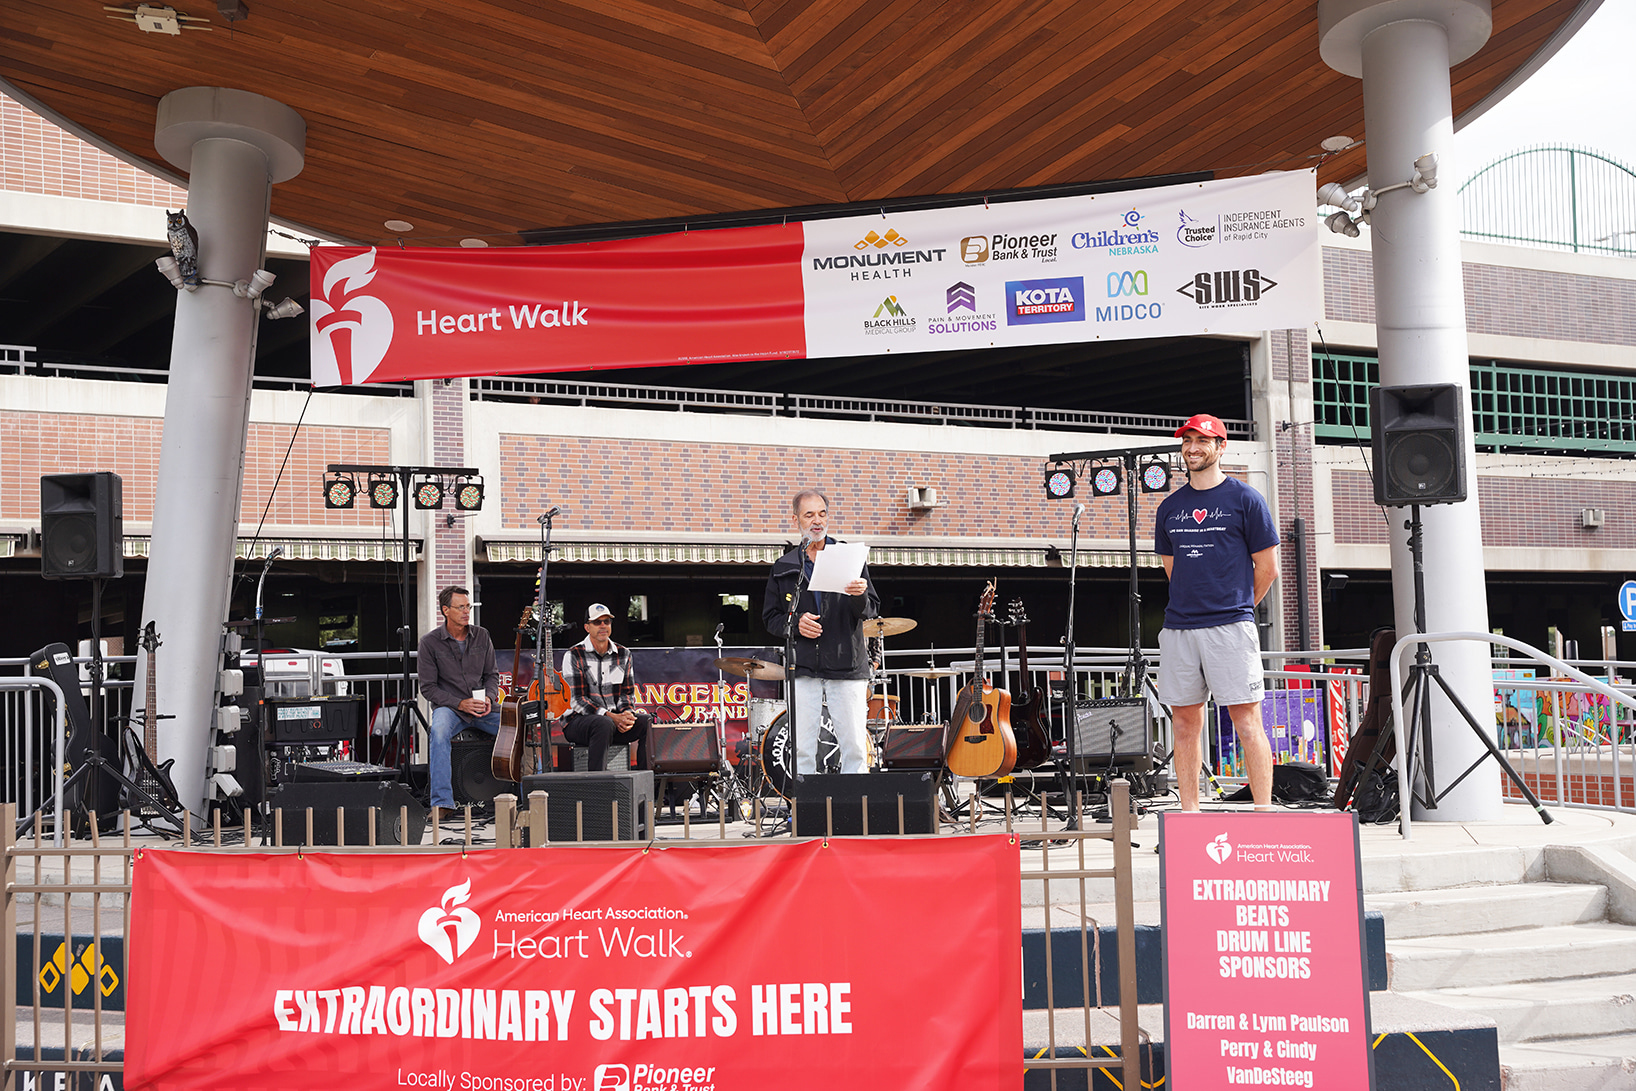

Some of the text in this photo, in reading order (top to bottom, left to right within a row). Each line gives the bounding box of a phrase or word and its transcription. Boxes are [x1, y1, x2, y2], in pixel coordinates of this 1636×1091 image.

[1224, 210, 1281, 222] INDEPENDENT
[1224, 218, 1305, 232] INSURANCE AGENTS
[1184, 226, 1216, 235] Trusted
[1185, 234, 1212, 242] Choice
[1233, 234, 1252, 242] Rapid
[1254, 232, 1268, 240] City
[992, 233, 1057, 250] Pioneer
[1071, 230, 1159, 250] Children's
[813, 249, 946, 270] MONUMENT
[992, 247, 1057, 260] Bank & Trust
[1109, 245, 1159, 256] NEBRASKA
[850, 268, 912, 281] HEALTH
[1016, 288, 1074, 306] KOTA
[416, 300, 588, 336] Heart Walk
[1018, 303, 1074, 315] TERRITORY
[1096, 302, 1162, 322] MIDCO
[864, 318, 916, 328] BLACK HILLS
[928, 320, 997, 334] SOLUTIONS
[694, 705, 748, 722] BAND
[1237, 850, 1274, 862] Heart
[1192, 880, 1330, 902] EXTRAORDINARY
[495, 909, 560, 922] American
[562, 908, 602, 920] Heart
[1236, 905, 1289, 926] BEATS
[492, 929, 589, 960] Heart
[1217, 930, 1312, 952] DRUM LINE
[1220, 956, 1312, 979] SPONSORS
[273, 982, 852, 1042] EXTRAORDINARY STARTS HERE
[1187, 1012, 1350, 1033] Darren & Lynn Paulson
[1220, 1039, 1317, 1060] Perry & Cindy
[398, 1068, 586, 1091] Locally Sponsored by:
[633, 1064, 716, 1084] Pioneer
[1227, 1066, 1314, 1088] VanDeSteeg
